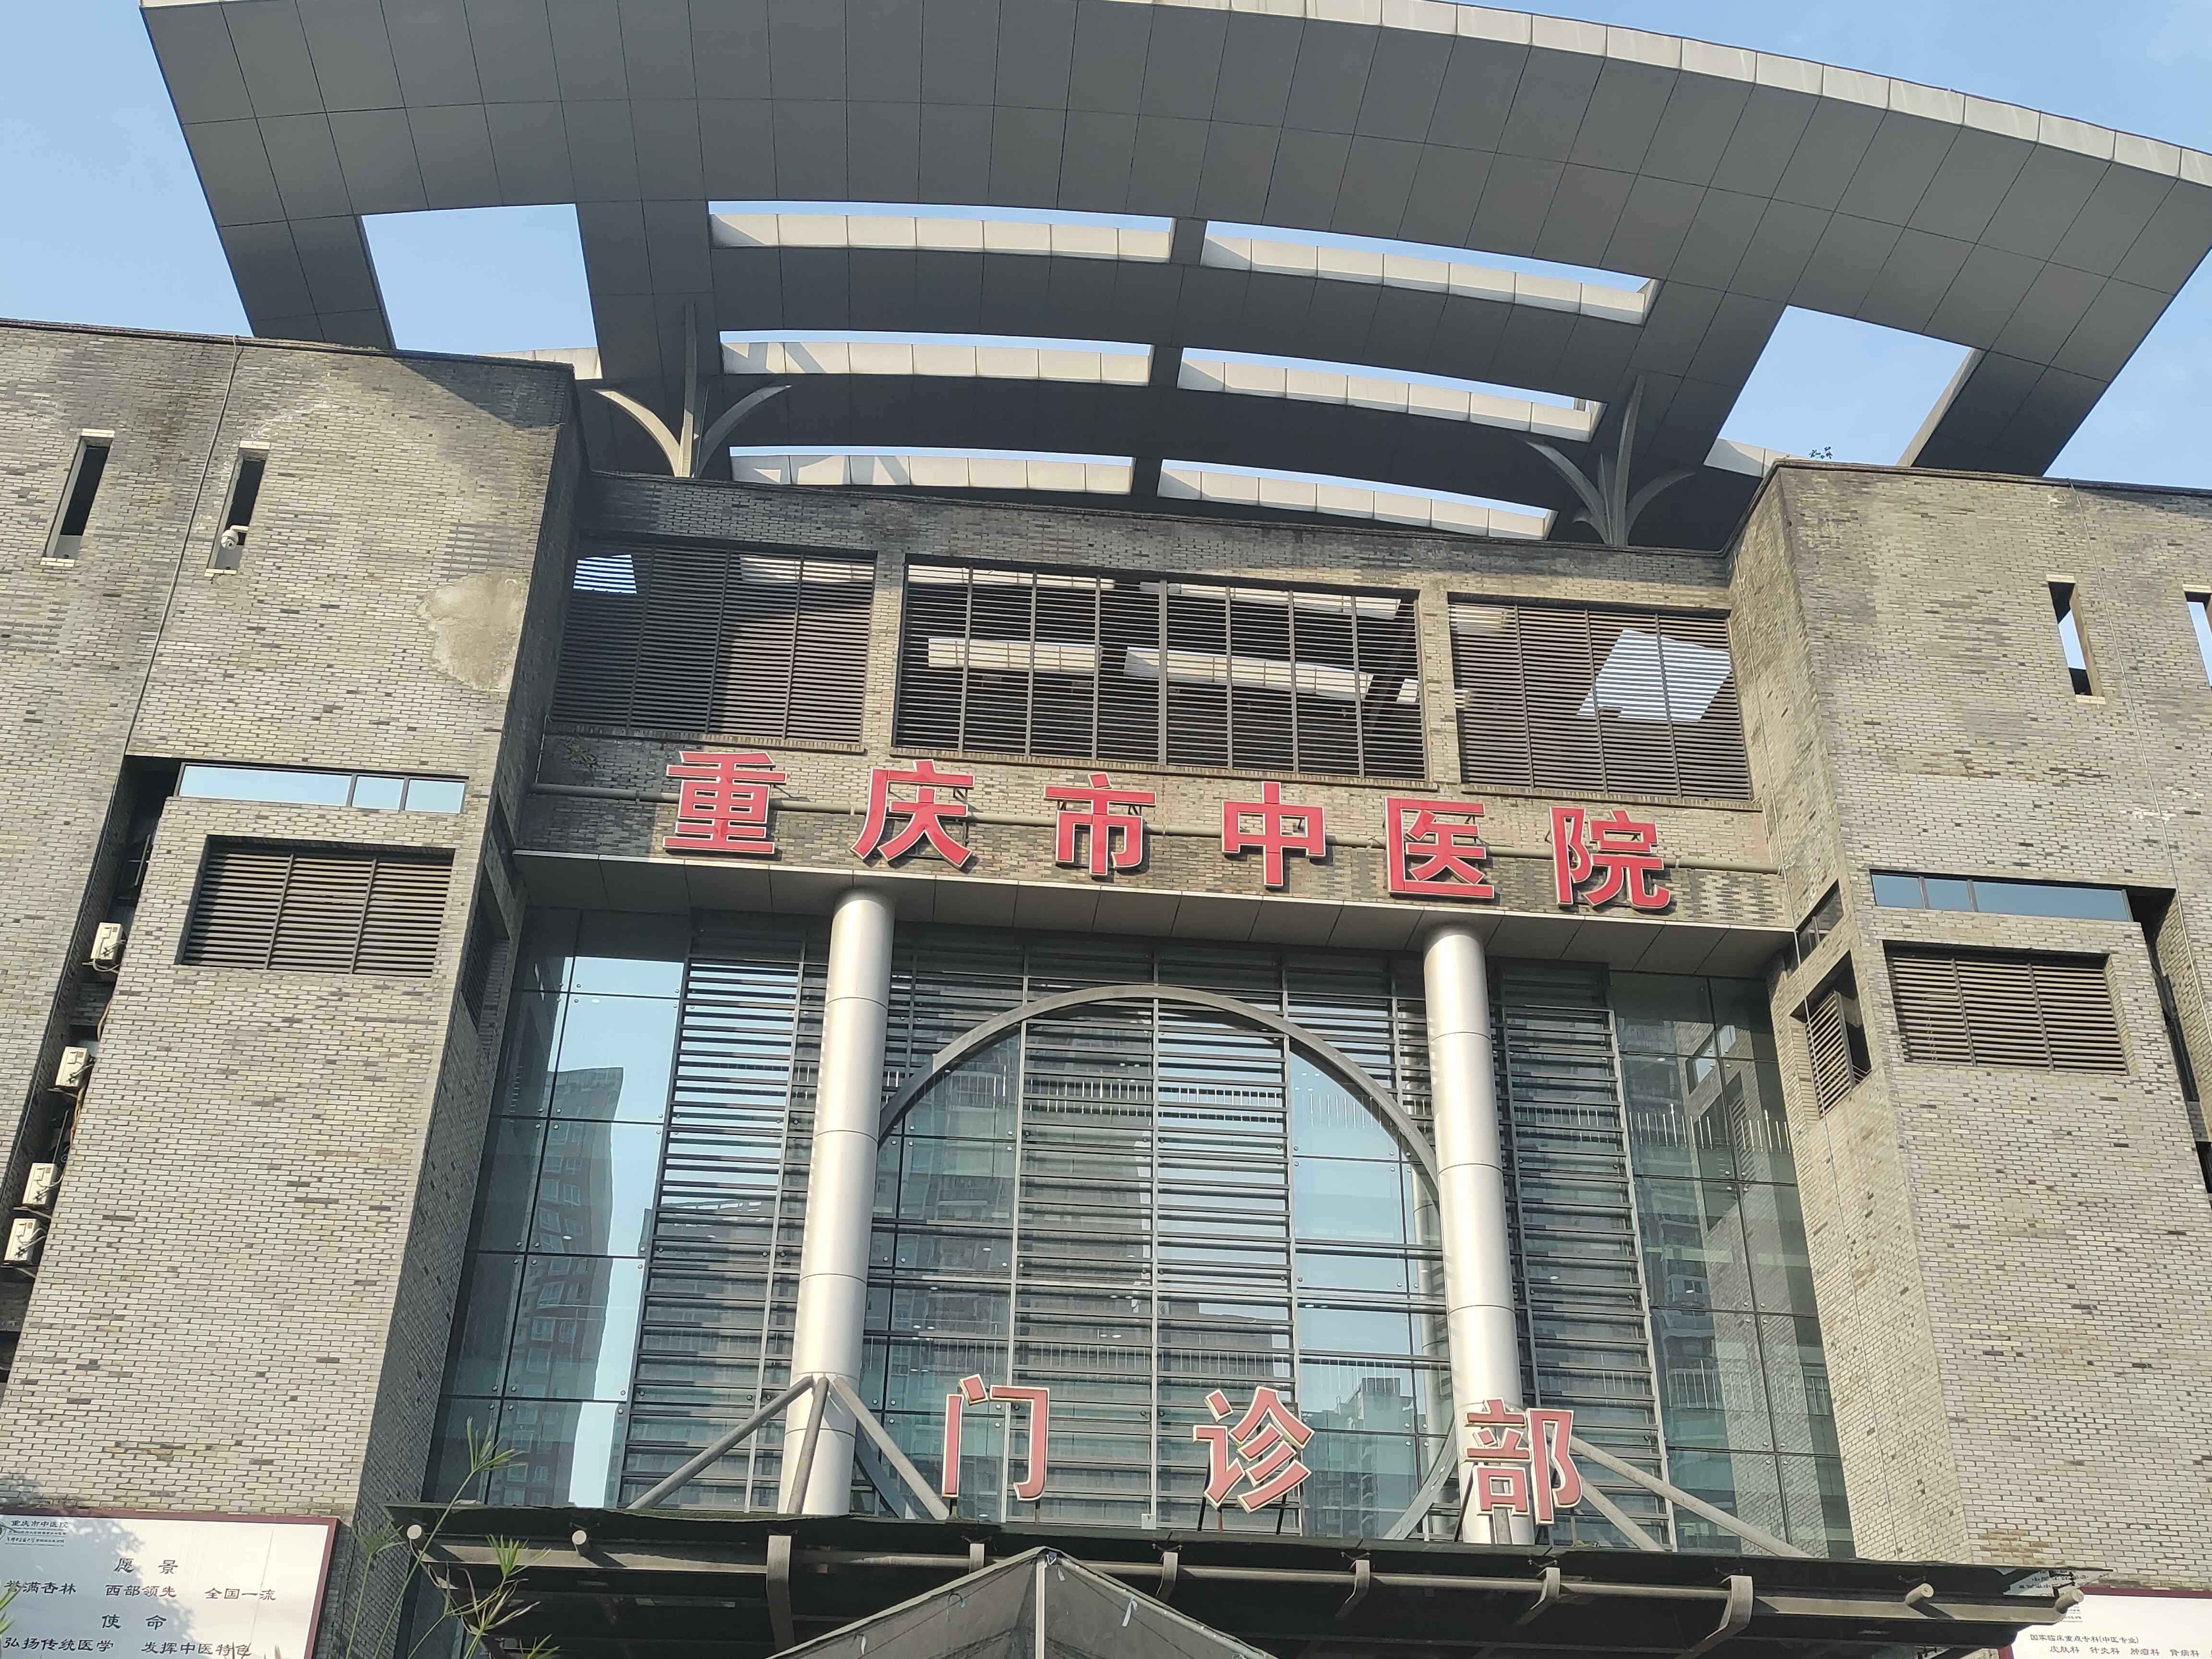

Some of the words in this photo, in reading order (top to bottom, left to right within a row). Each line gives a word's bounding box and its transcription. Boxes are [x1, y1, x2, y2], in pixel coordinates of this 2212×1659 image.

[663, 751, 1671, 909] 重庆市中医院
[942, 1374, 1583, 1525] 门诊部
[12, 1520, 69, 1528] 重庆市中医院
[4, 1580, 77, 1595] 誉满杏林
[105, 1584, 177, 1598] 西部领先
[204, 1587, 276, 1601] 全国一流
[102, 1614, 167, 1630] 使命
[2, 1637, 114, 1652] 弘扬传统医学
[141, 1641, 252, 1657] 发挥中医特色
[2089, 1647, 2120, 1655] 针灸科
